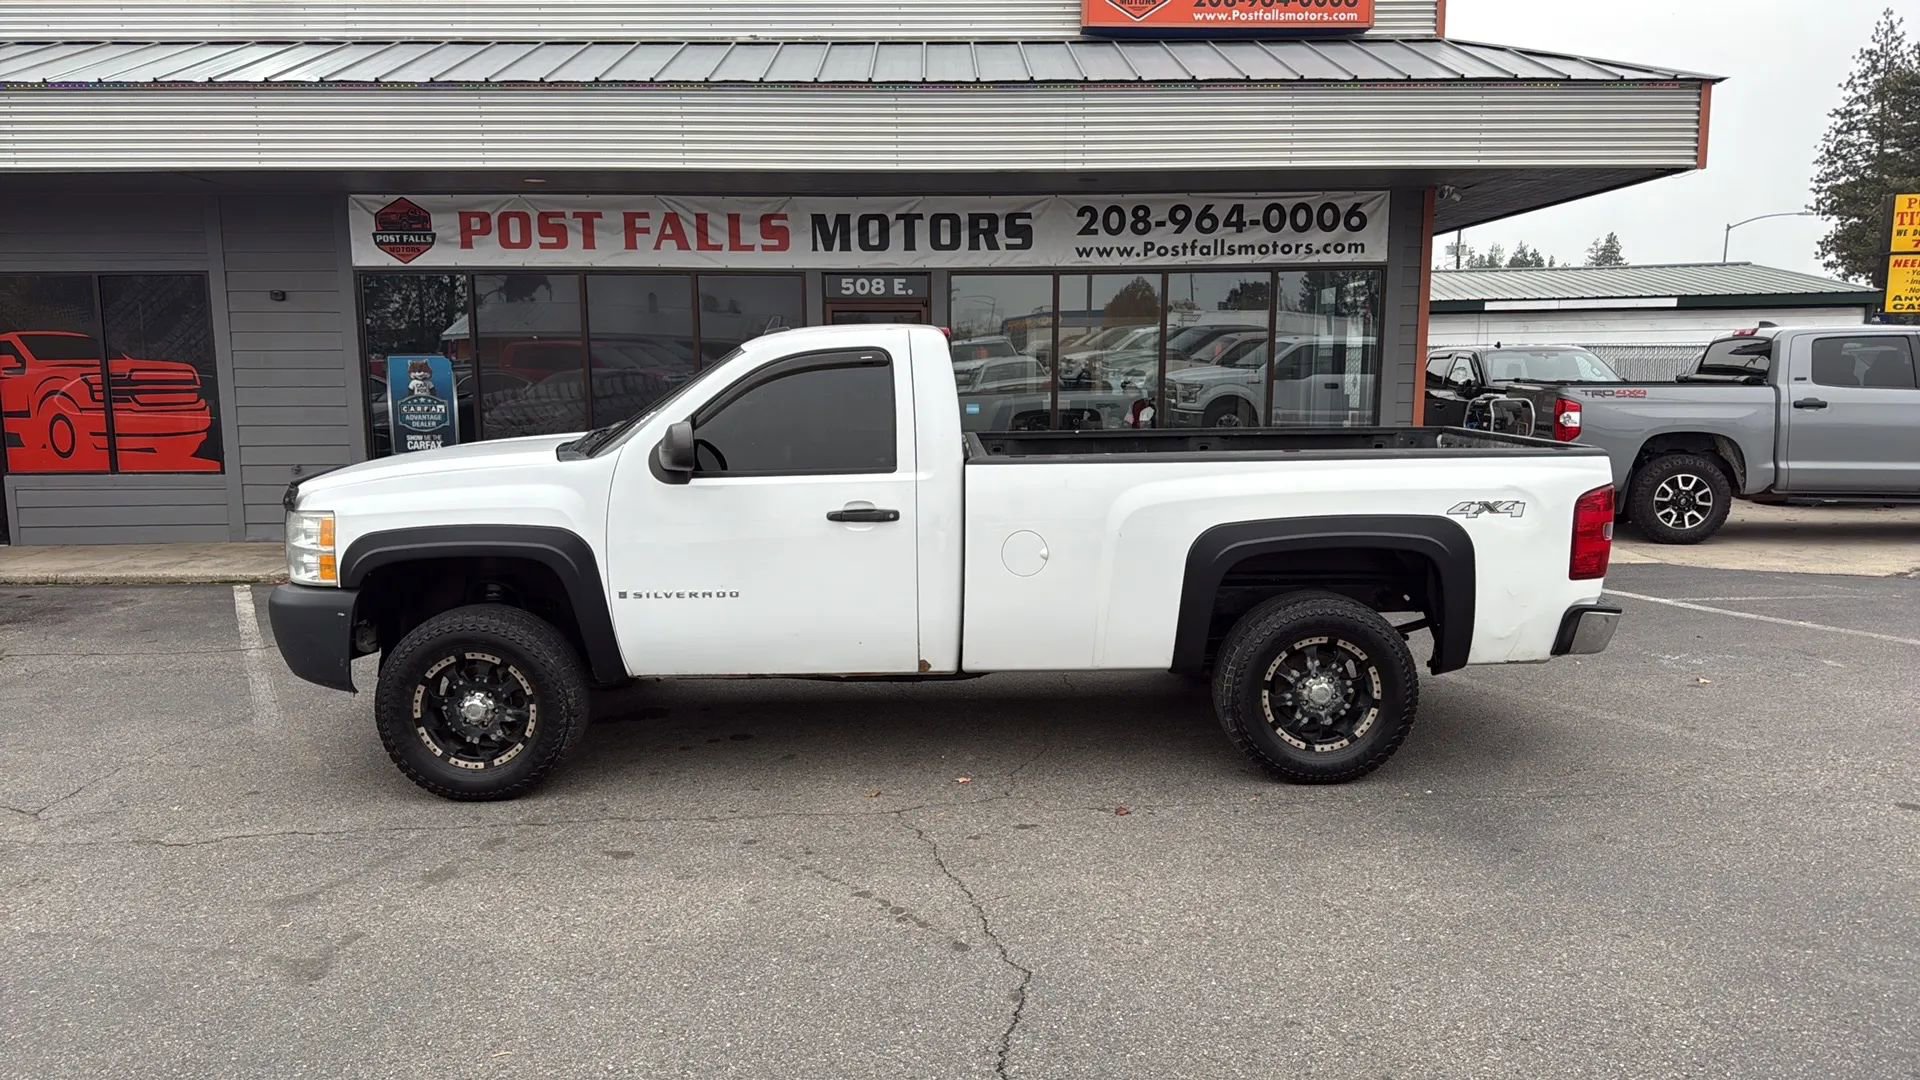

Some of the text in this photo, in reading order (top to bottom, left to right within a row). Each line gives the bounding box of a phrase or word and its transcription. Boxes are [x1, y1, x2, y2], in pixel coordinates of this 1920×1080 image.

[1193, 9, 1358, 21] www.Postfallsmotors.com
[1907, 197, 1920, 209] P
[1076, 202, 1368, 236] 208-964-0006
[457, 210, 1034, 252] POST FALLS MOTORS
[376, 235, 433, 243] POST FALLS
[1075, 238, 1365, 258] www.Postfallsmotors.com
[841, 278, 914, 295] 508 E.
[1581, 389, 1615, 398] TRD
[408, 441, 443, 450] CARFAX
[633, 591, 740, 600] SILVERADO
